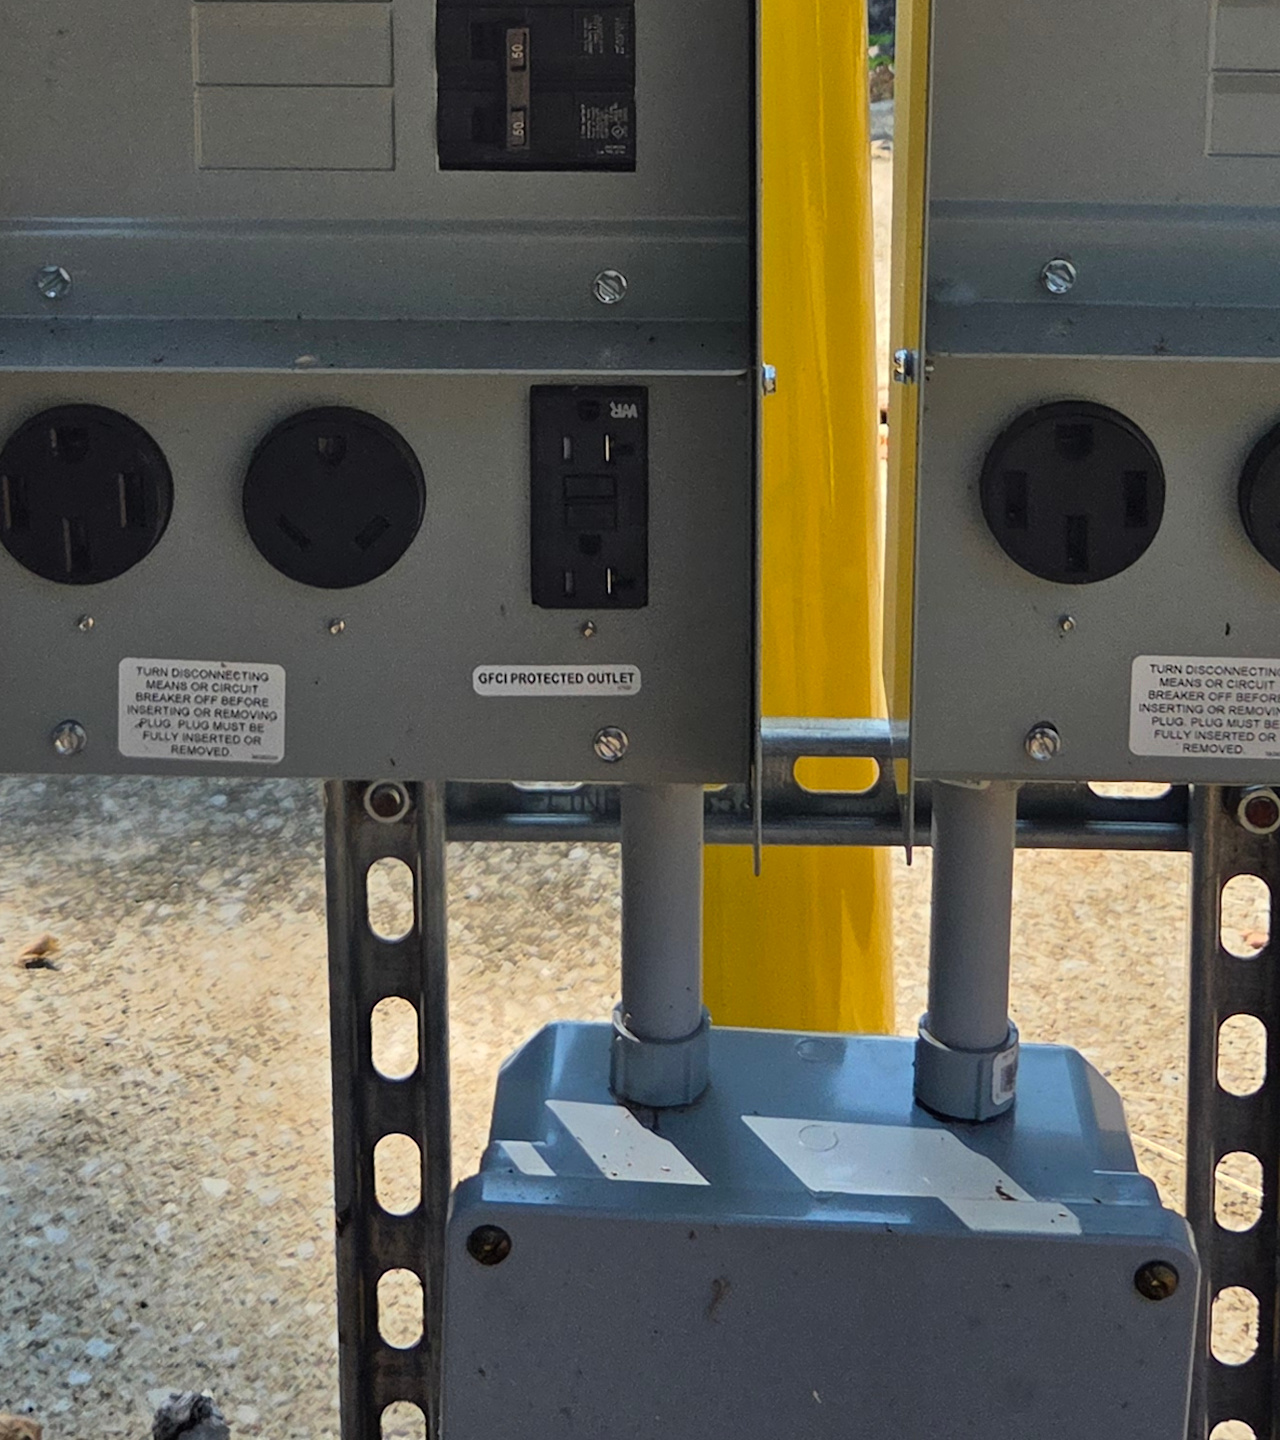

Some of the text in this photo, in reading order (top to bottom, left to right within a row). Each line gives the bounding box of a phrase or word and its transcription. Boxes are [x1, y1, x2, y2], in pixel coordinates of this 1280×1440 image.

[511, 43, 524, 60] 50
[609, 401, 638, 419] WR
[136, 666, 269, 682] TURN DISCONNECTING
[1150, 664, 1182, 674] TURN
[478, 672, 635, 684] GFCI PROTECTED OUTLET
[1159, 678, 1275, 690] MEANS OR CIRCUIT
[145, 680, 258, 693] MEANS OR CIRCUIT
[135, 692, 269, 708] BREAKER OFF BEFORE
[1148, 690, 1205, 701] BREAKER
[1208, 692, 1232, 701] OFF
[127, 705, 278, 722] INSERTING OR REMOVING
[1139, 703, 1203, 714] INSERTING
[1207, 705, 1225, 715] OR
[178, 719, 209, 731] PLUG
[213, 721, 245, 732] MUST
[249, 723, 264, 733] BE
[1190, 717, 1223, 728] PLUG
[1226, 719, 1261, 729] MUST
[1264, 719, 1280, 729] BE
[142, 731, 262, 745] FULLY INSERTED OR
[1154, 730, 1276, 742] FULLY INSERTED OR
